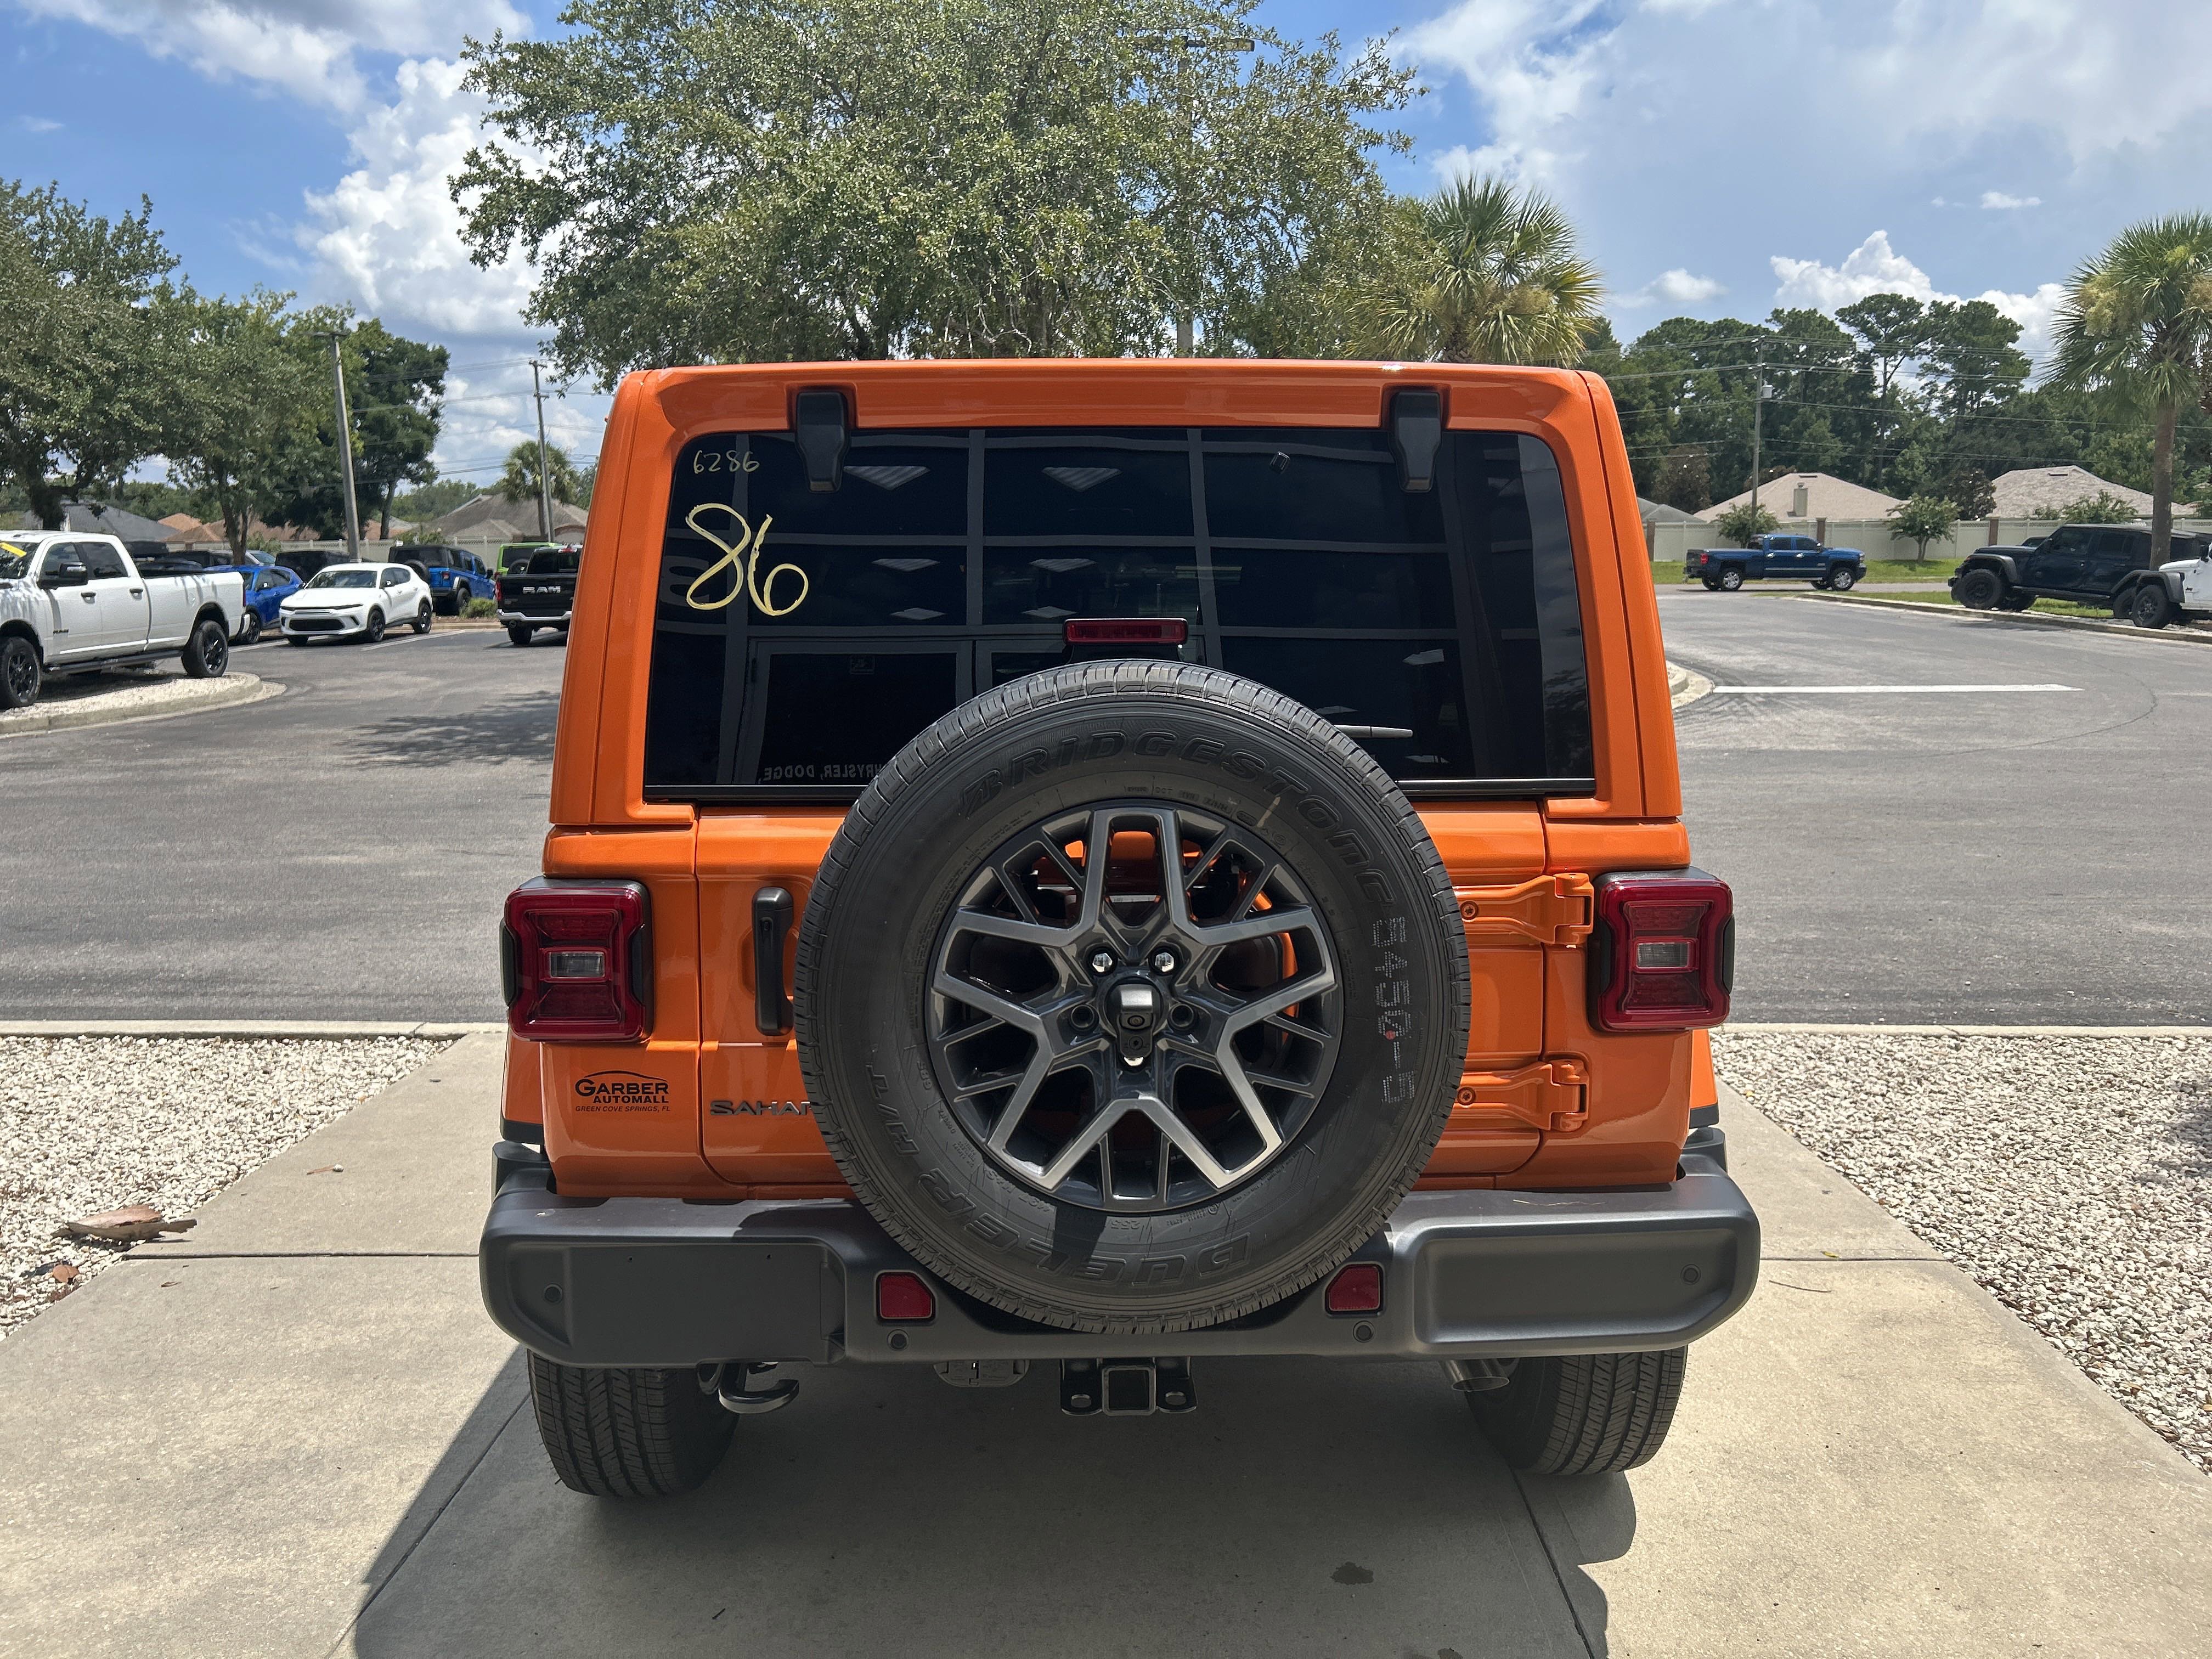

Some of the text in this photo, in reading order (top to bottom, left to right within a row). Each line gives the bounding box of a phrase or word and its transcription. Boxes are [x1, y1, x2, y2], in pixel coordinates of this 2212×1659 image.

[693, 449, 760, 474] 6286
[685, 503, 809, 617] 86
[958, 729, 1394, 908] BRIDGESTONE
[575, 1079, 669, 1097] GARBER
[592, 1095, 669, 1104] AUTOMALL
[917, 1167, 1250, 1287] DUELER
